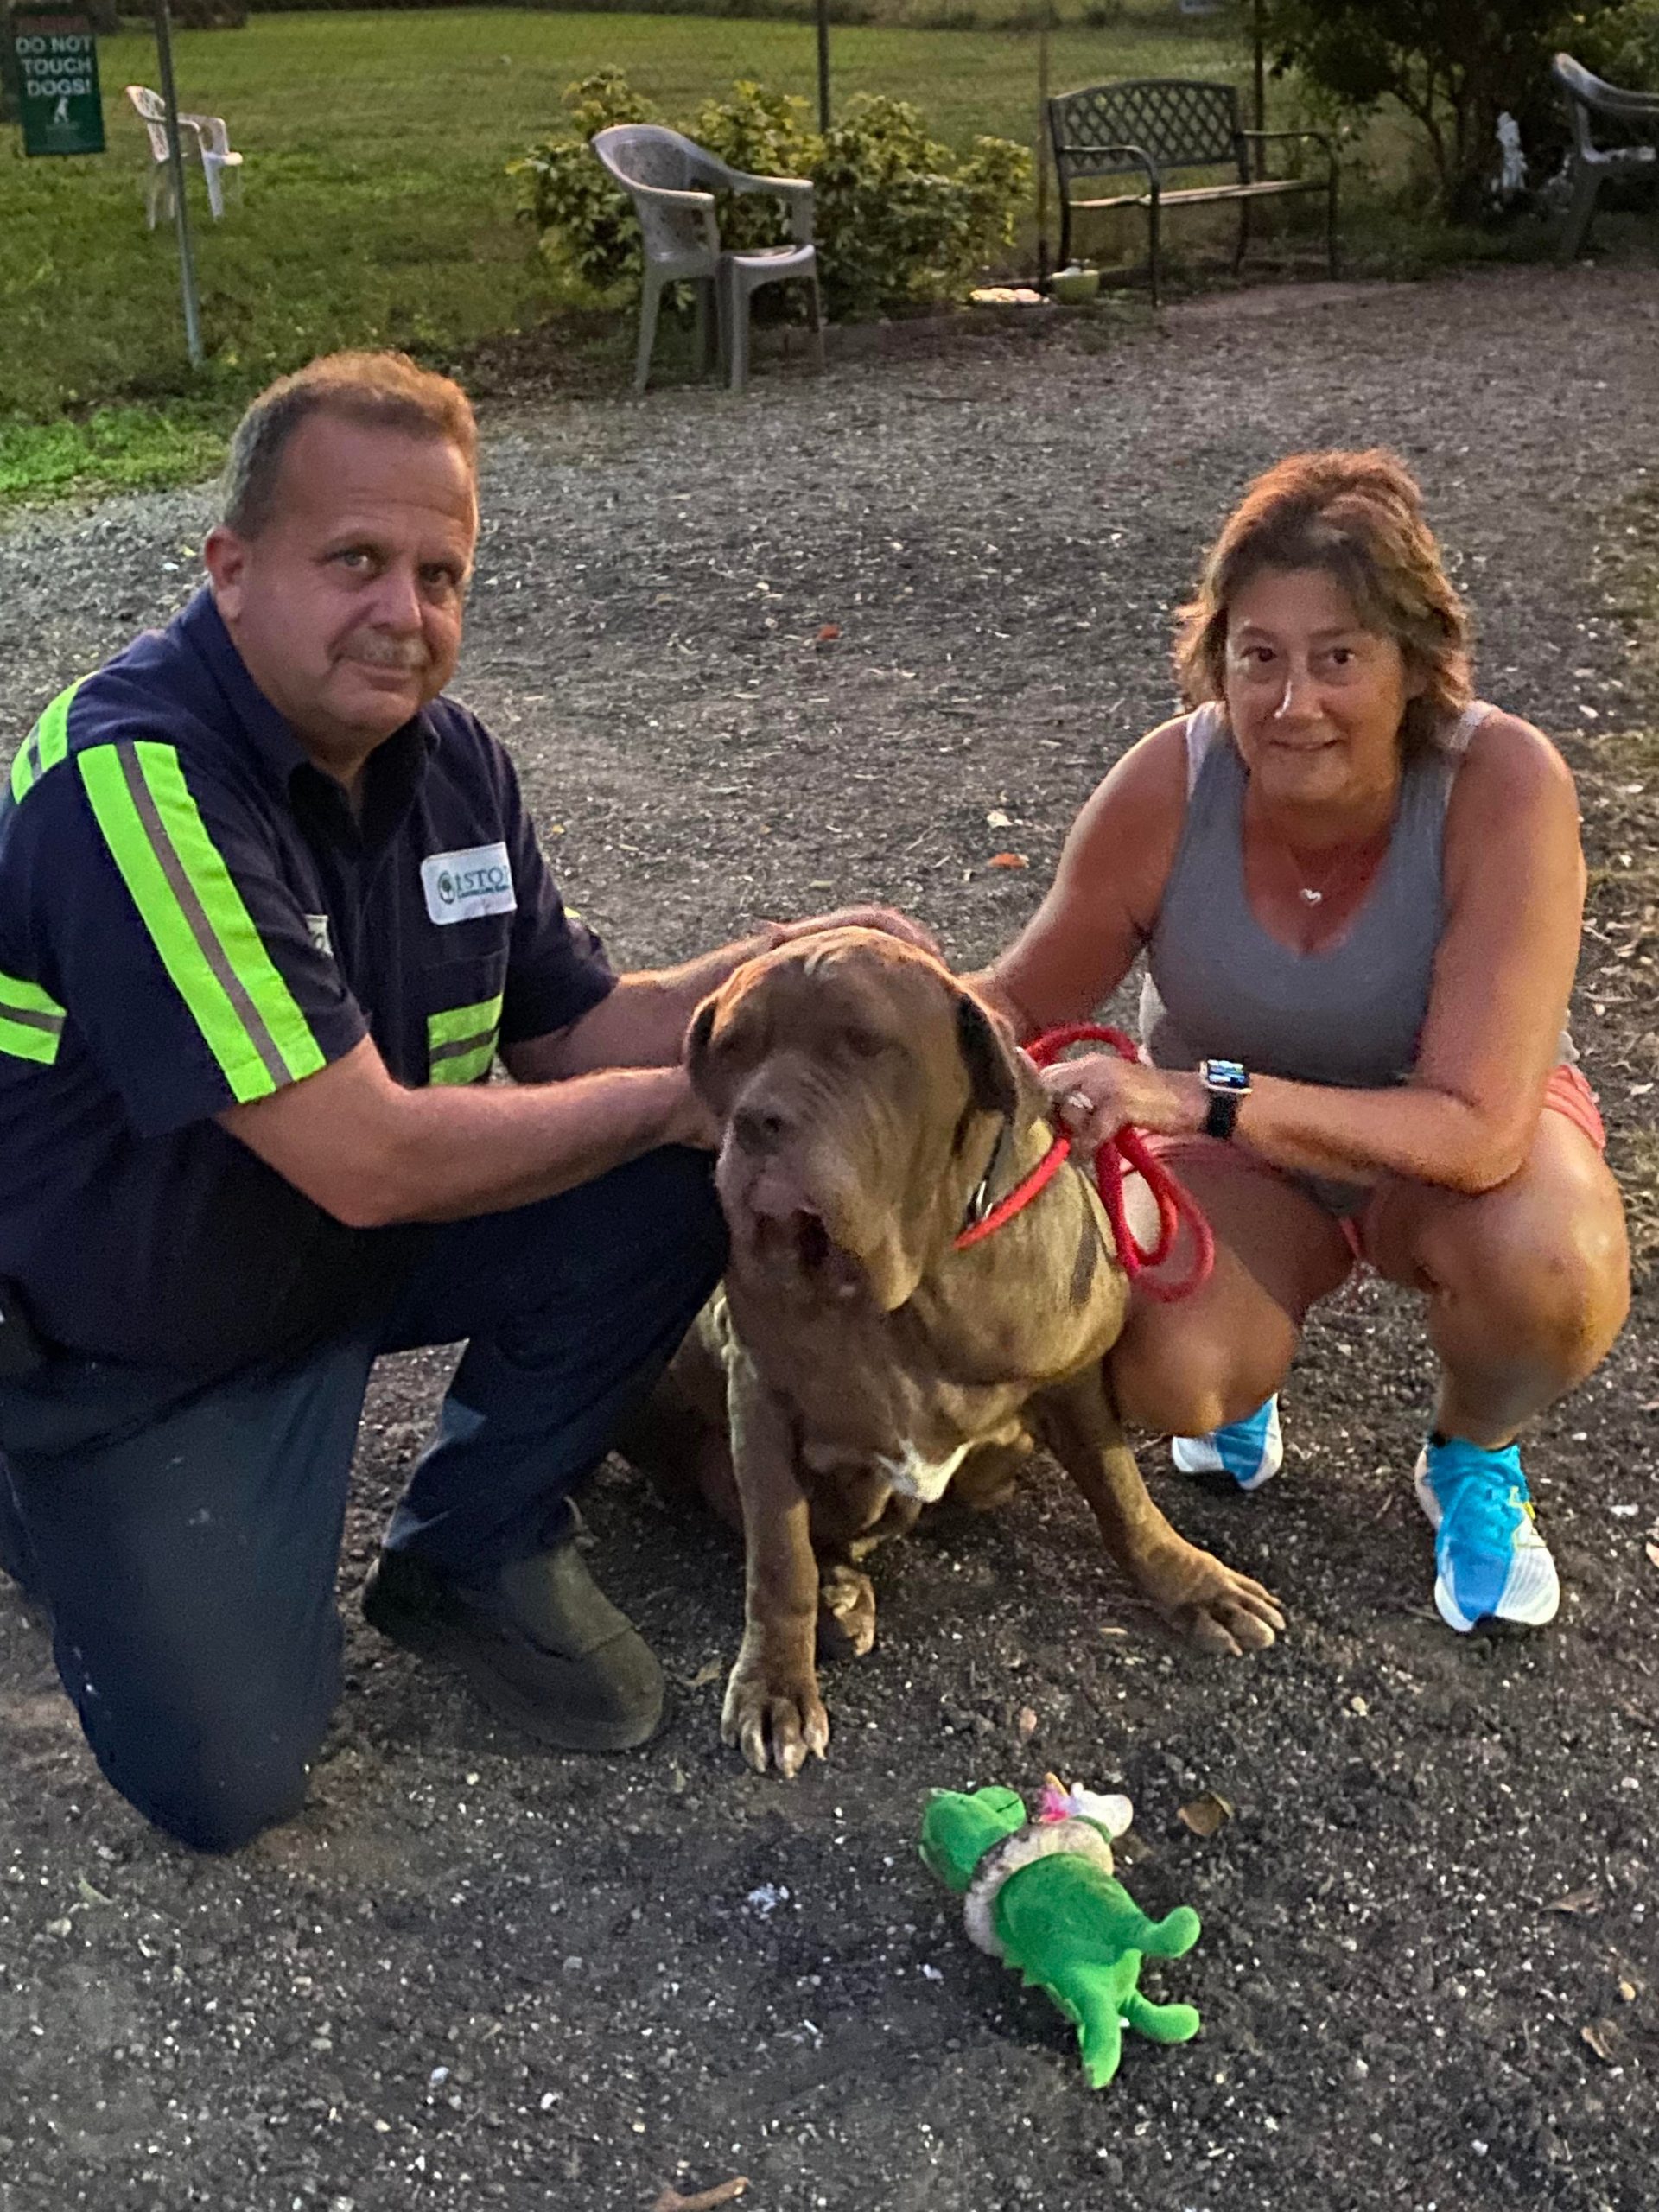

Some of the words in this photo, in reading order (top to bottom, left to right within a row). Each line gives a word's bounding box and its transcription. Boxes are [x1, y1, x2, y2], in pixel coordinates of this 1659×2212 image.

[16, 36, 46, 54] DO
[51, 35, 92, 53] NOT
[21, 57, 92, 76] TOUCH
[27, 79, 92, 97] DOGS!
